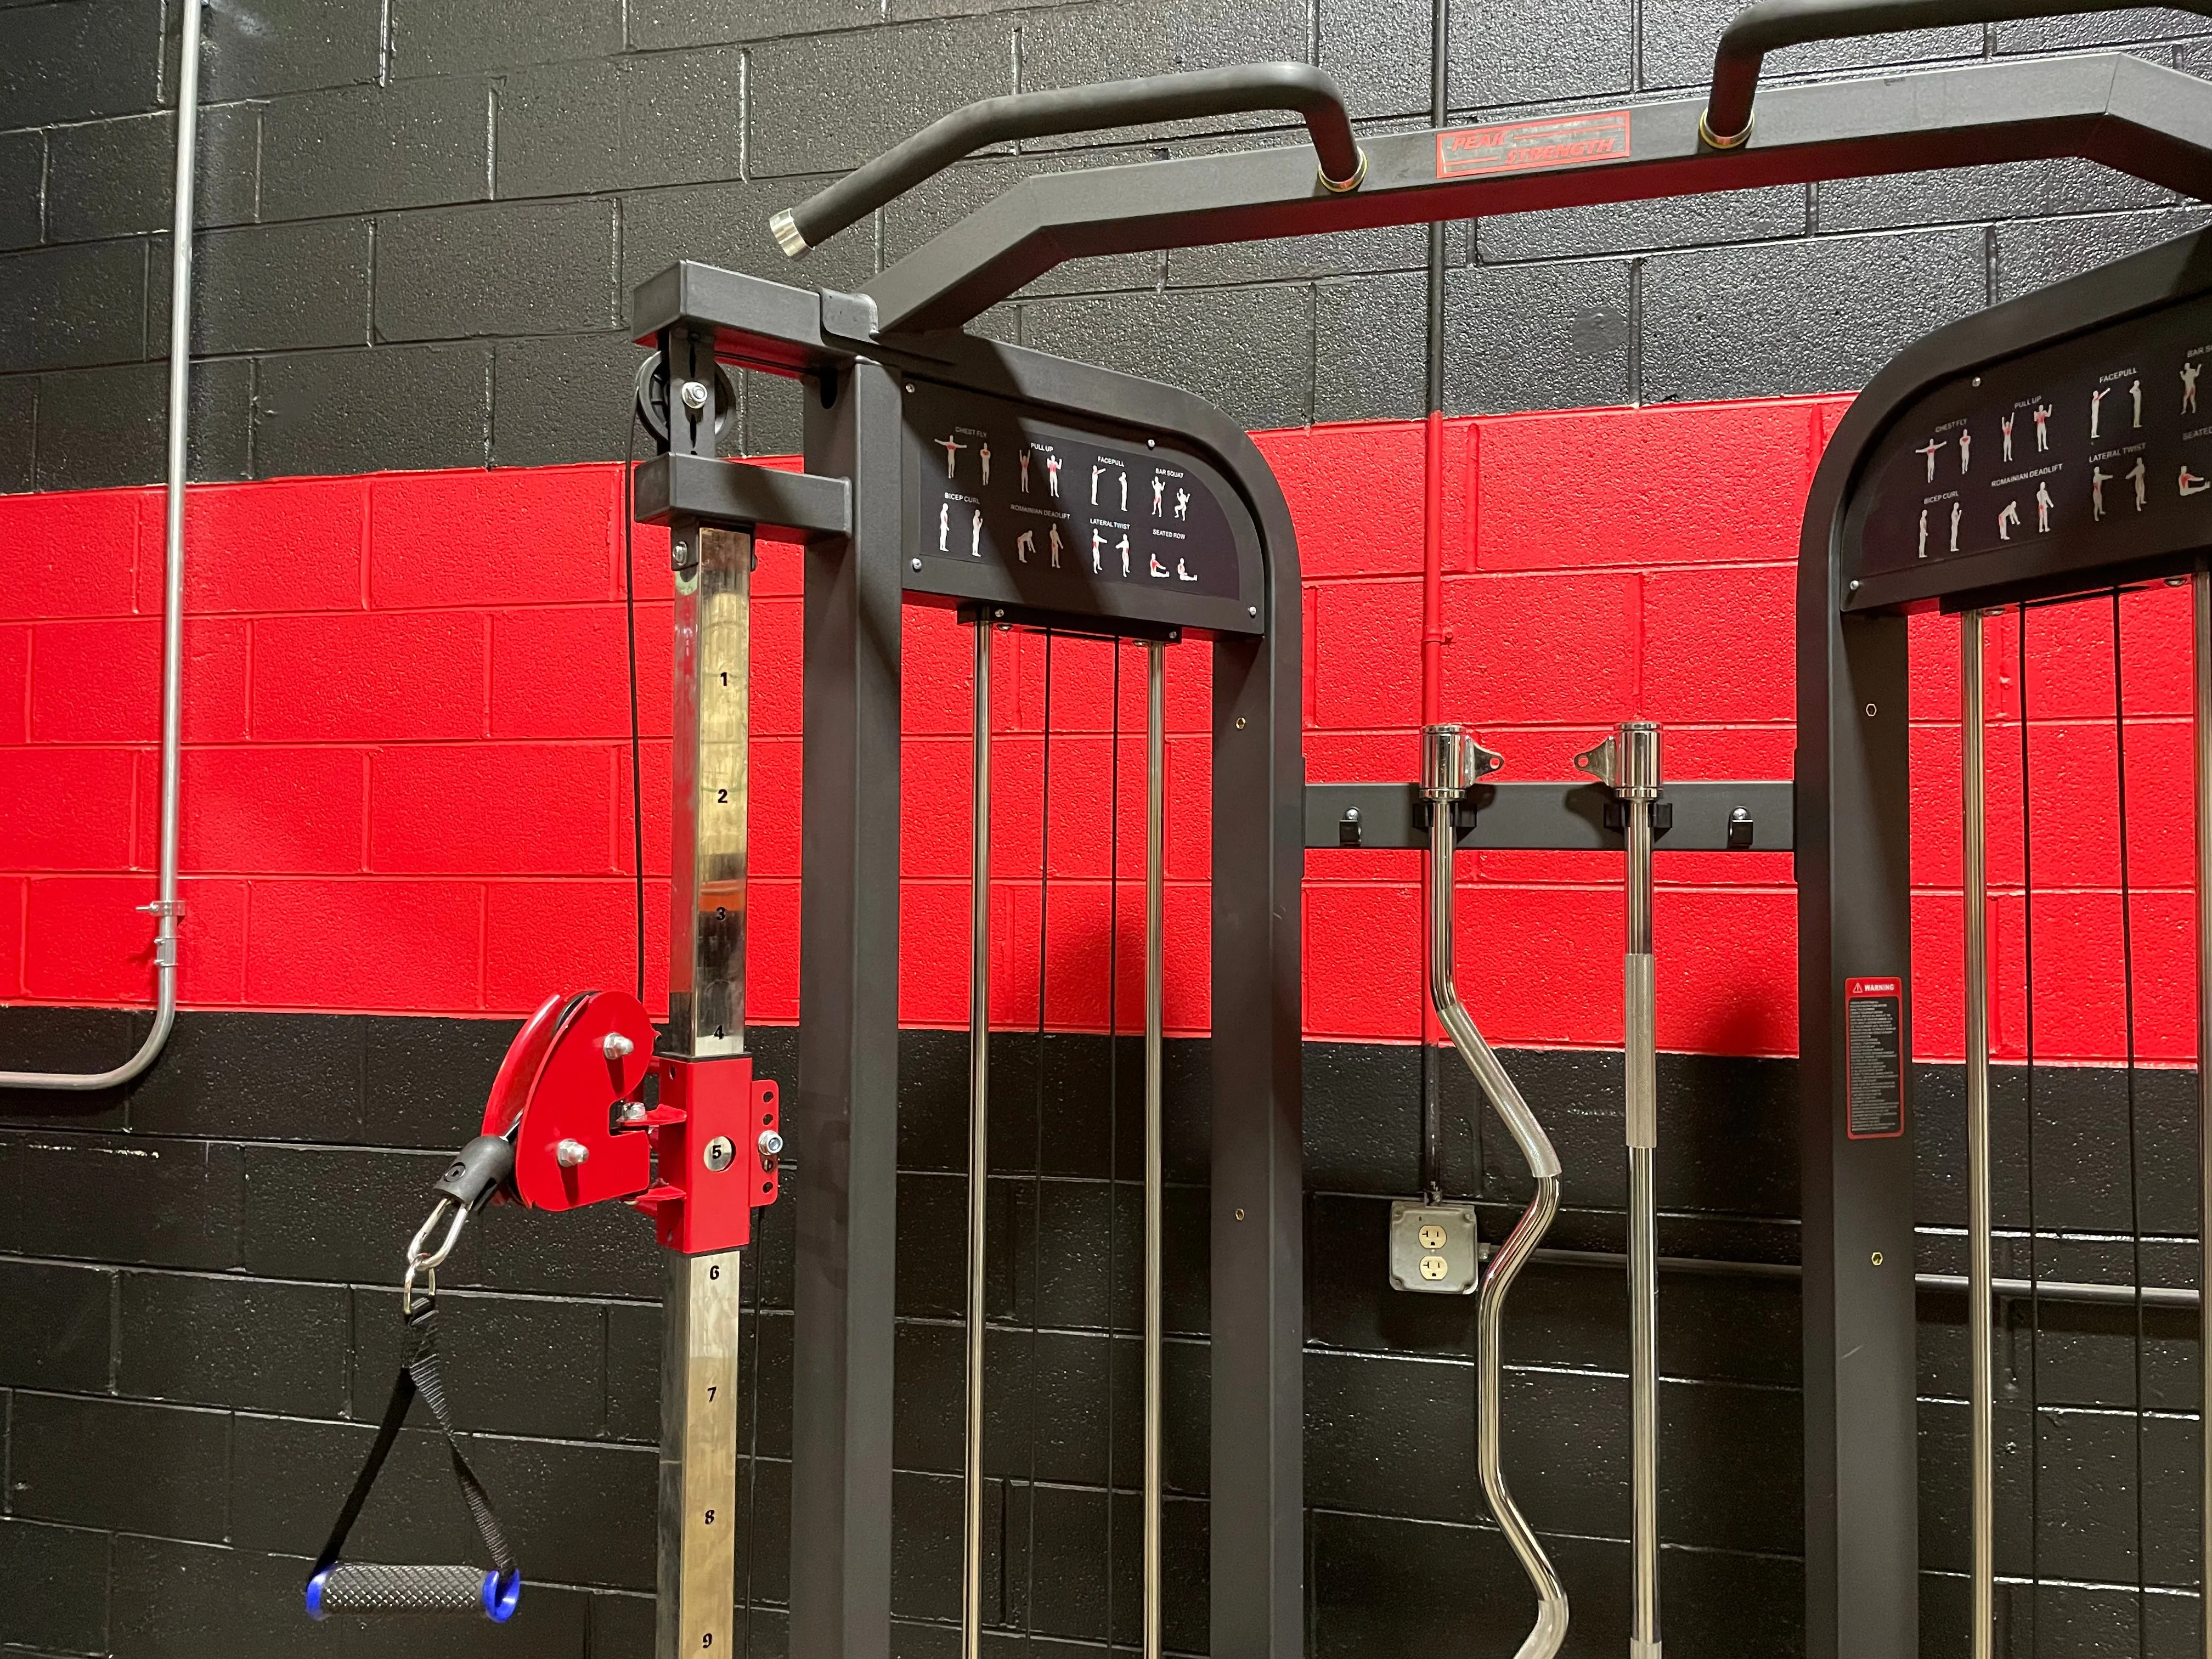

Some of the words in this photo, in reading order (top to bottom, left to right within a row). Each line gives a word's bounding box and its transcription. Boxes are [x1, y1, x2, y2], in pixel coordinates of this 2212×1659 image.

[1451, 131, 1508, 151] PEAK
[1505, 137, 1616, 164] STRENGTH
[2187, 347, 2204, 358] BAR
[2099, 367, 2137, 383] FACEPULL
[2014, 399, 2030, 409] PULL
[2032, 396, 2041, 404] UP
[955, 427, 975, 435] CHEST
[1935, 422, 1956, 433] CHEST
[1956, 419, 1967, 427] FLY
[1030, 442, 1045, 451] PULL
[2089, 449, 2121, 462] LATERAL
[2122, 442, 2147, 454] TWIST
[1098, 456, 1125, 467] FACEPULL
[1991, 472, 2028, 487] ROMAINIAN
[2029, 464, 2063, 478] DEADLIFT
[945, 493, 963, 501] BICEP
[964, 496, 980, 504] CURL
[1924, 494, 1942, 505] BICEP
[1943, 490, 1959, 500] CURL
[1010, 504, 1042, 515] ROMAINIAN
[1043, 510, 1070, 520] DEADLIFT
[1090, 518, 1113, 527] LATERAL
[1153, 529, 1172, 538] SEATED
[720, 672, 727, 686] 1
[718, 789, 727, 804] 2
[716, 907, 726, 921] 3
[1864, 984, 1894, 992] WARNING
[714, 1025, 724, 1039] 4
[712, 1145, 722, 1159] 5
[709, 1265, 720, 1280] 6
[707, 1386, 716, 1403] 7
[704, 1510, 715, 1524] 8
[702, 1633, 713, 1648] 9
